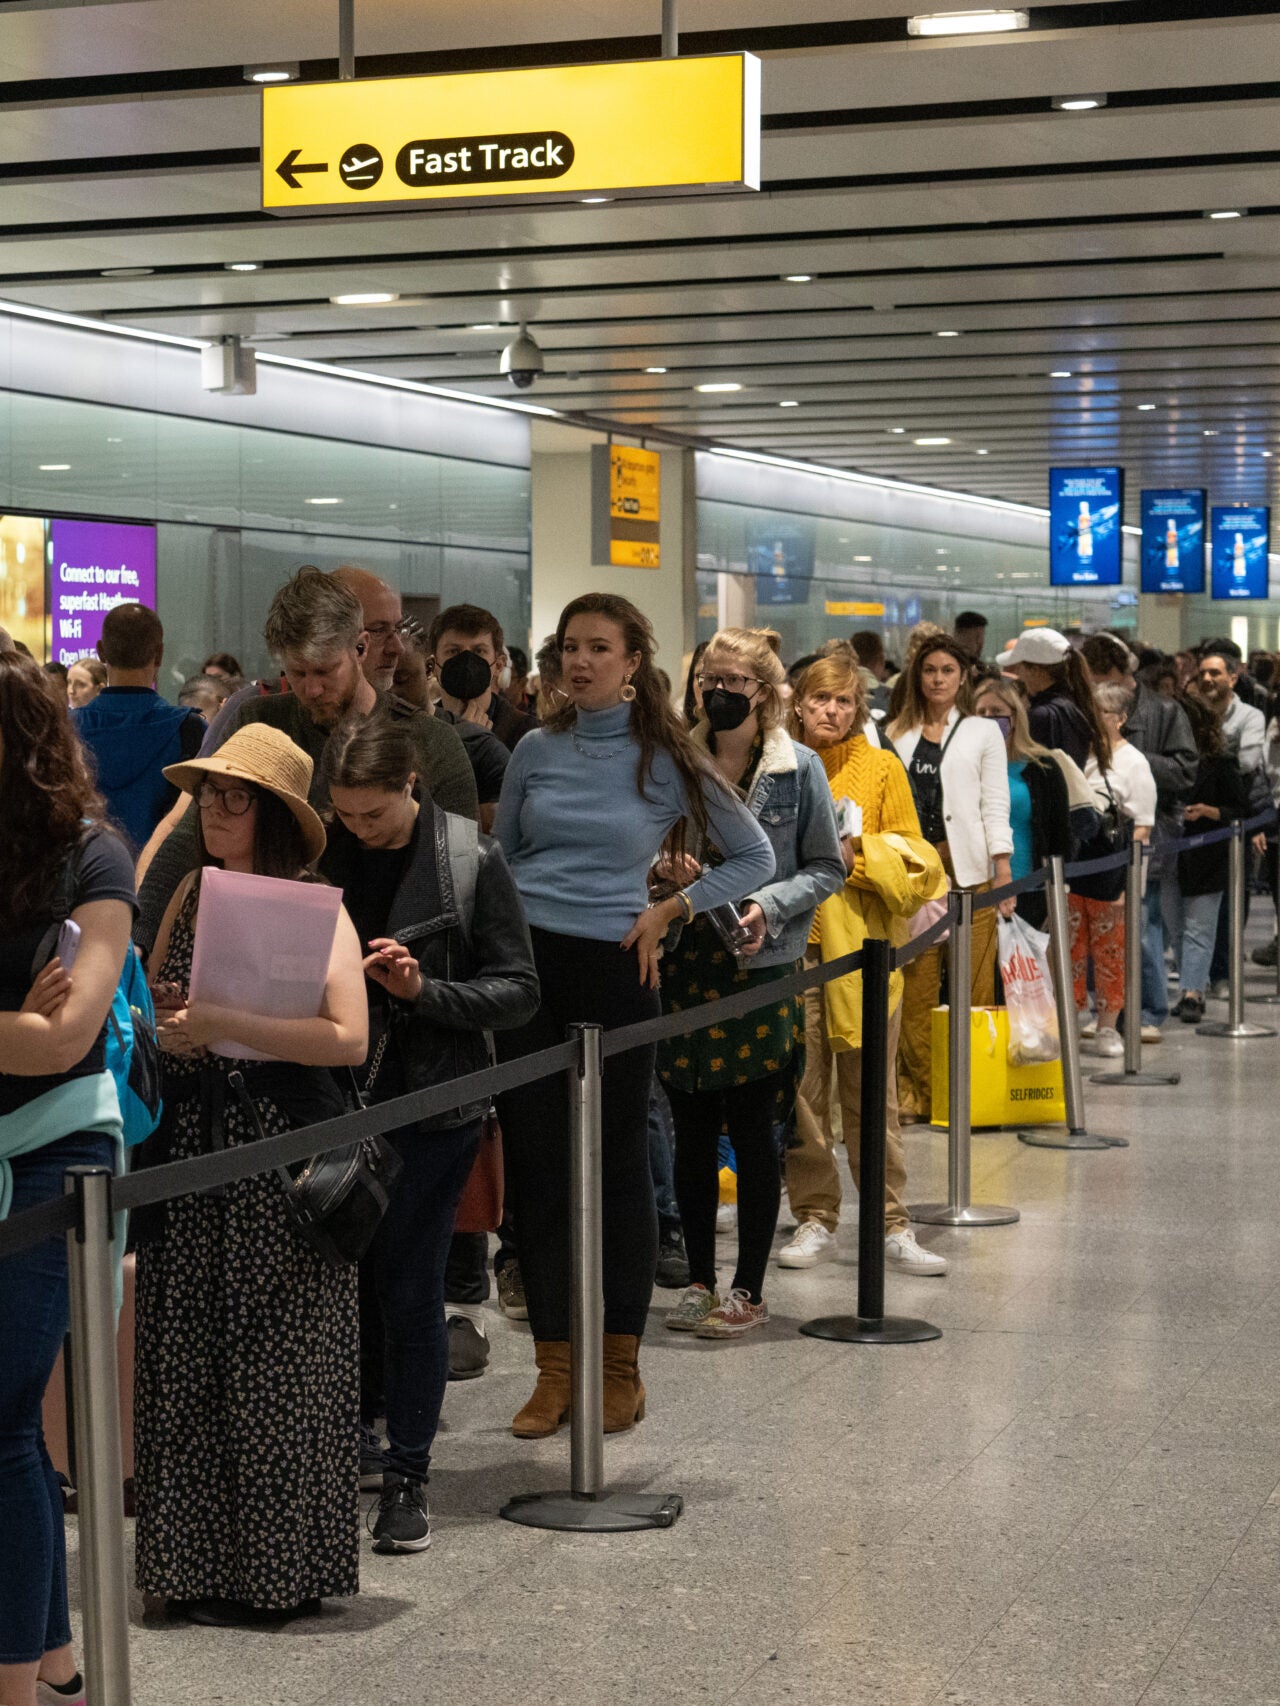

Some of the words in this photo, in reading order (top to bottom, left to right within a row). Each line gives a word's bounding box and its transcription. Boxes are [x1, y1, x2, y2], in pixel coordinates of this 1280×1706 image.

[409, 147, 472, 175] Fast
[478, 139, 564, 170] Track
[60, 562, 95, 583] Connect
[95, 565, 105, 584] to
[105, 569, 121, 584] our
[121, 564, 139, 587] free,
[60, 590, 99, 615] superfast
[59, 619, 82, 638] Wi-Fi
[1010, 1087, 1054, 1102] SELFRIDGES
